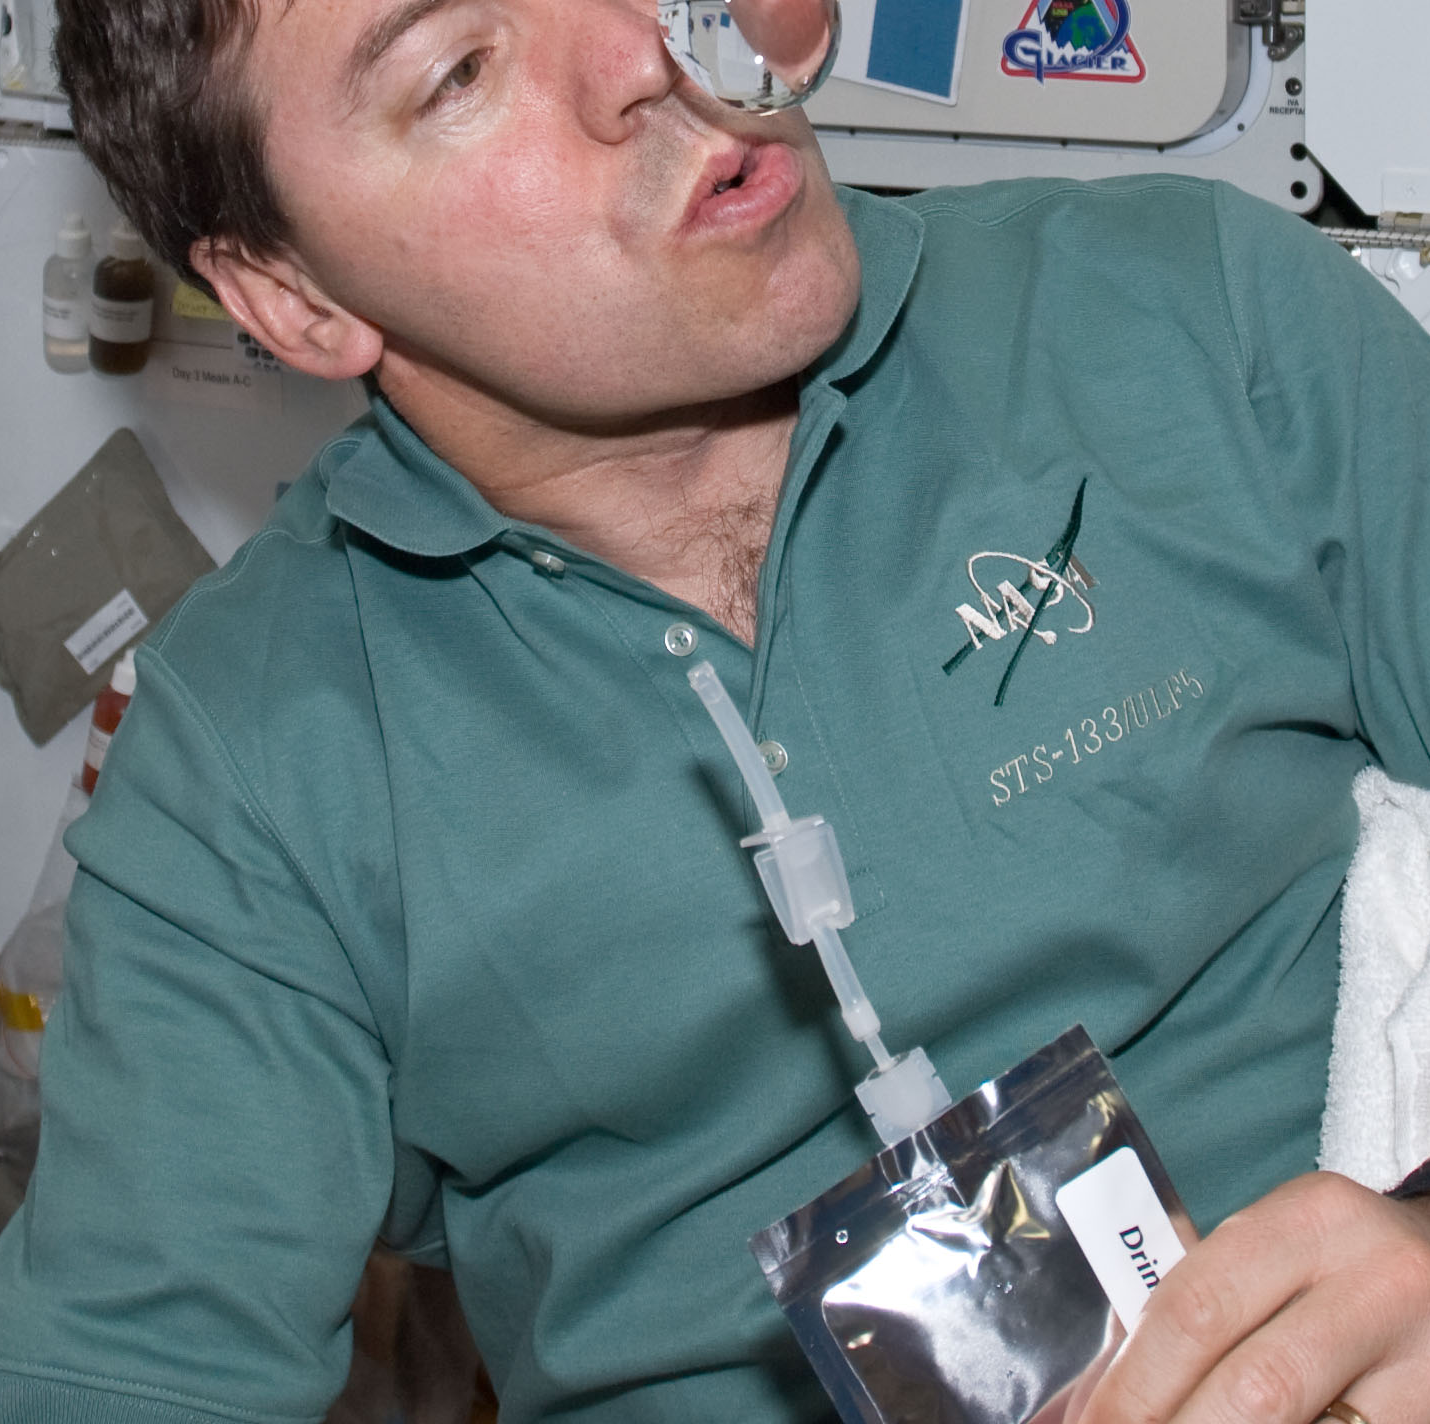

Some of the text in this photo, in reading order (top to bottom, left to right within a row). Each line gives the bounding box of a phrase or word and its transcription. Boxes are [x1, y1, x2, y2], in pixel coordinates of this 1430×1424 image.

[1002, 31, 1131, 88] GLACIER
[954, 551, 1099, 650] NASA
[989, 668, 1206, 808] STS-133/ULF5
